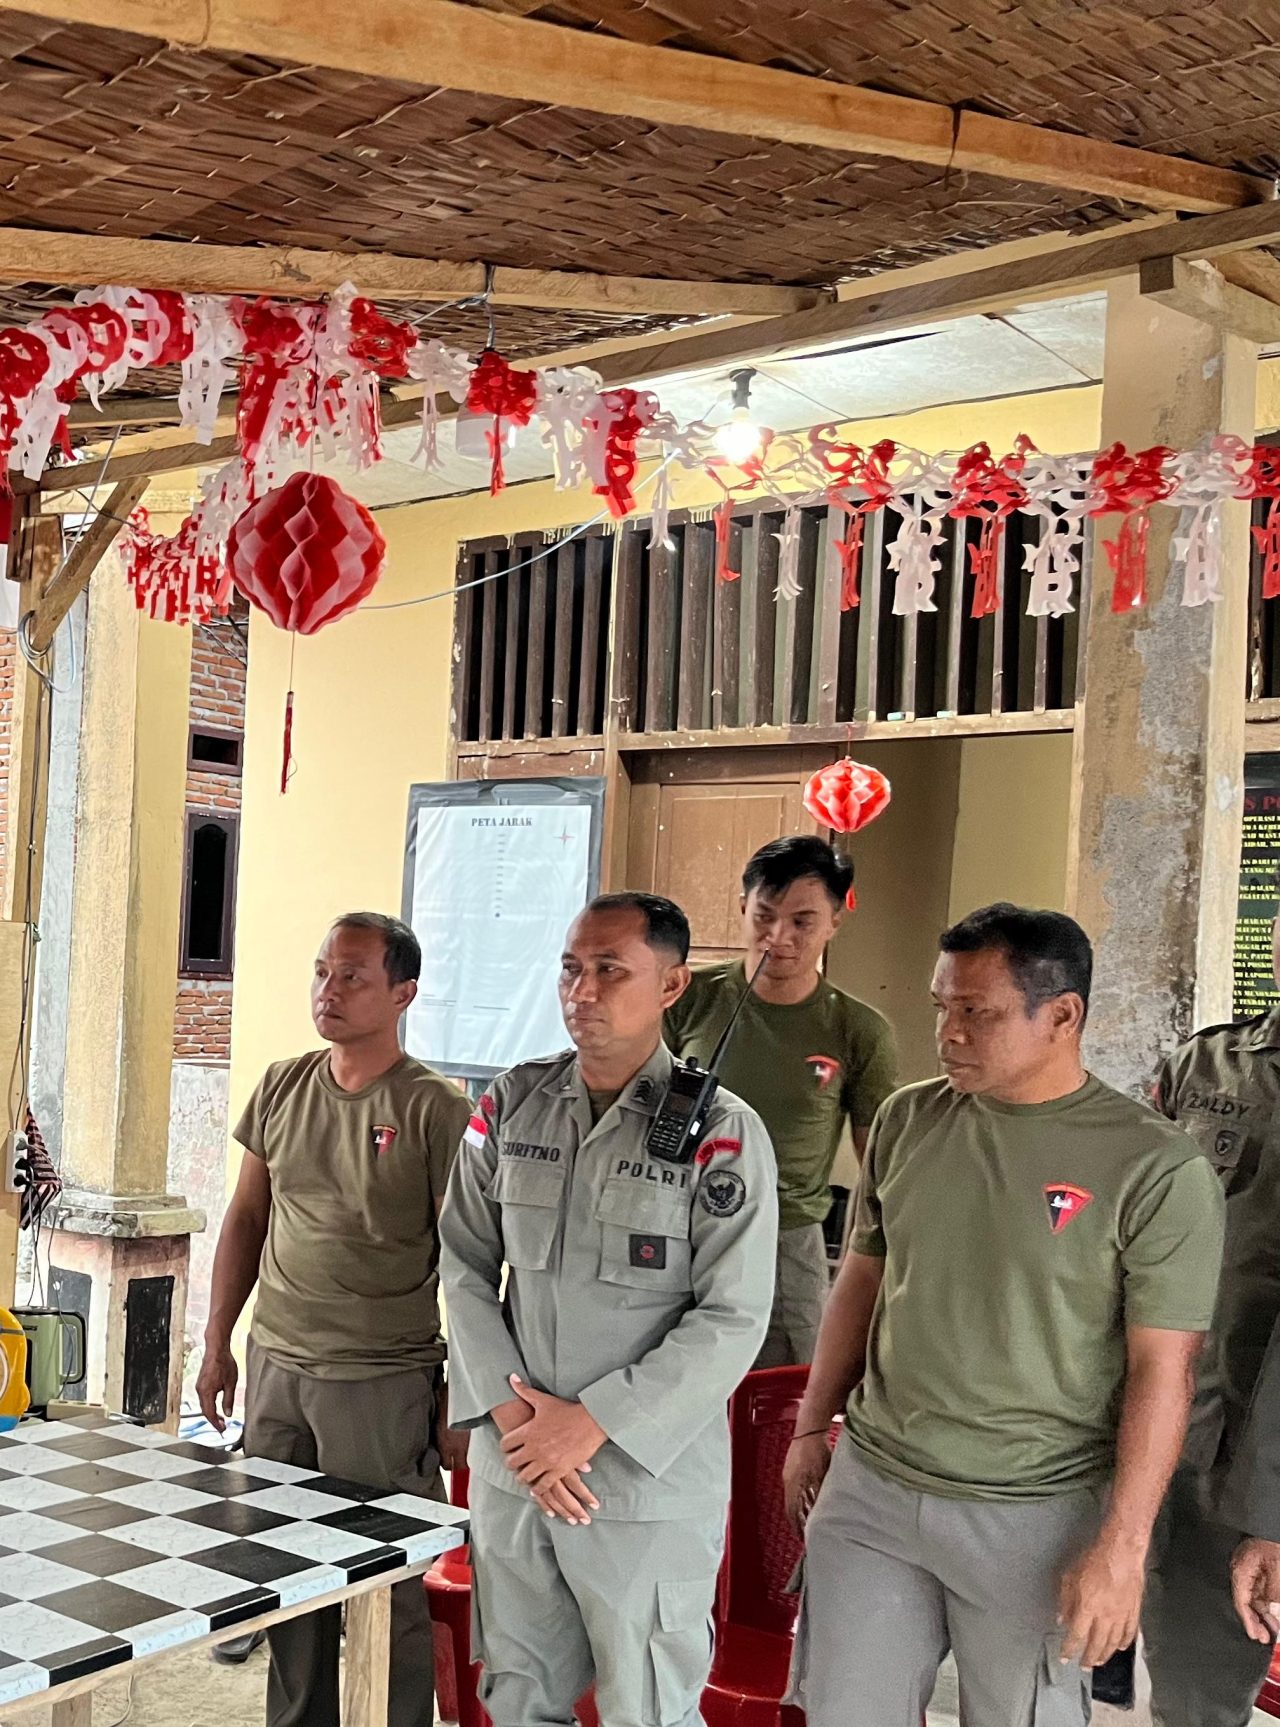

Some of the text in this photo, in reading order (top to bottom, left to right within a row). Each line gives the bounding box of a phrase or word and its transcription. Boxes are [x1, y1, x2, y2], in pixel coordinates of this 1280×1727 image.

[471, 817, 532, 827] PETA JARAK
[1188, 1093, 1250, 1119] ZALDY
[617, 1159, 686, 1189] POLRI
